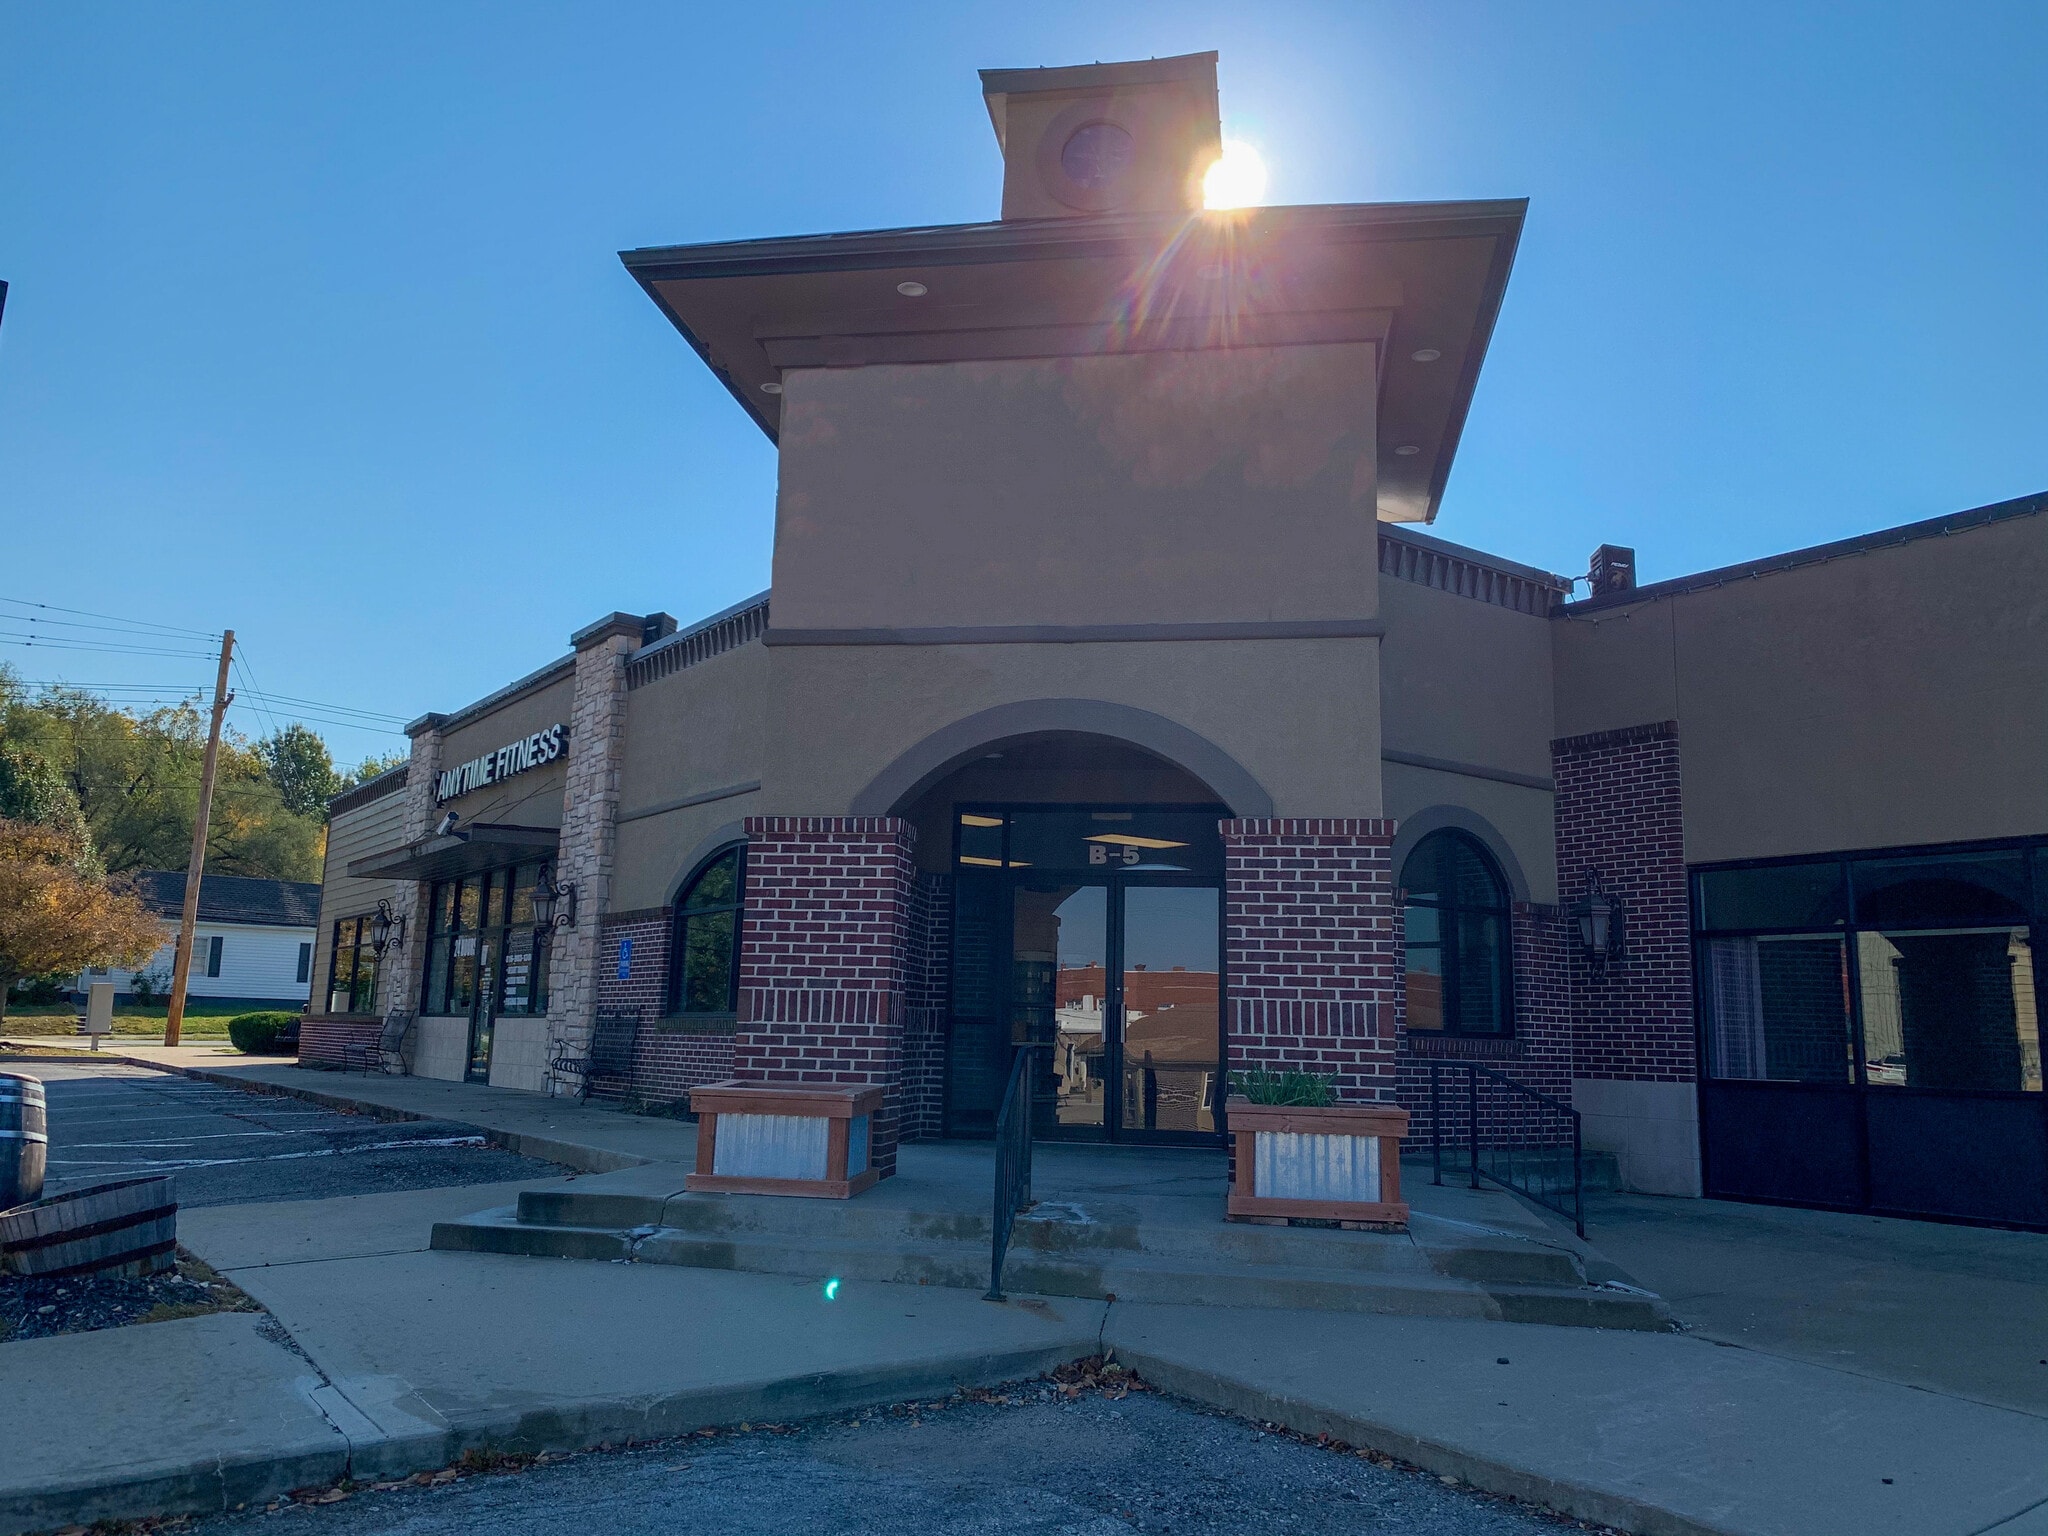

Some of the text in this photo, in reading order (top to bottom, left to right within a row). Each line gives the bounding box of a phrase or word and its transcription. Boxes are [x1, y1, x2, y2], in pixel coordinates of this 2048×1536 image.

[437, 723, 563, 802] ANYTIME FITNESS
[1089, 845, 1140, 865] B-5
